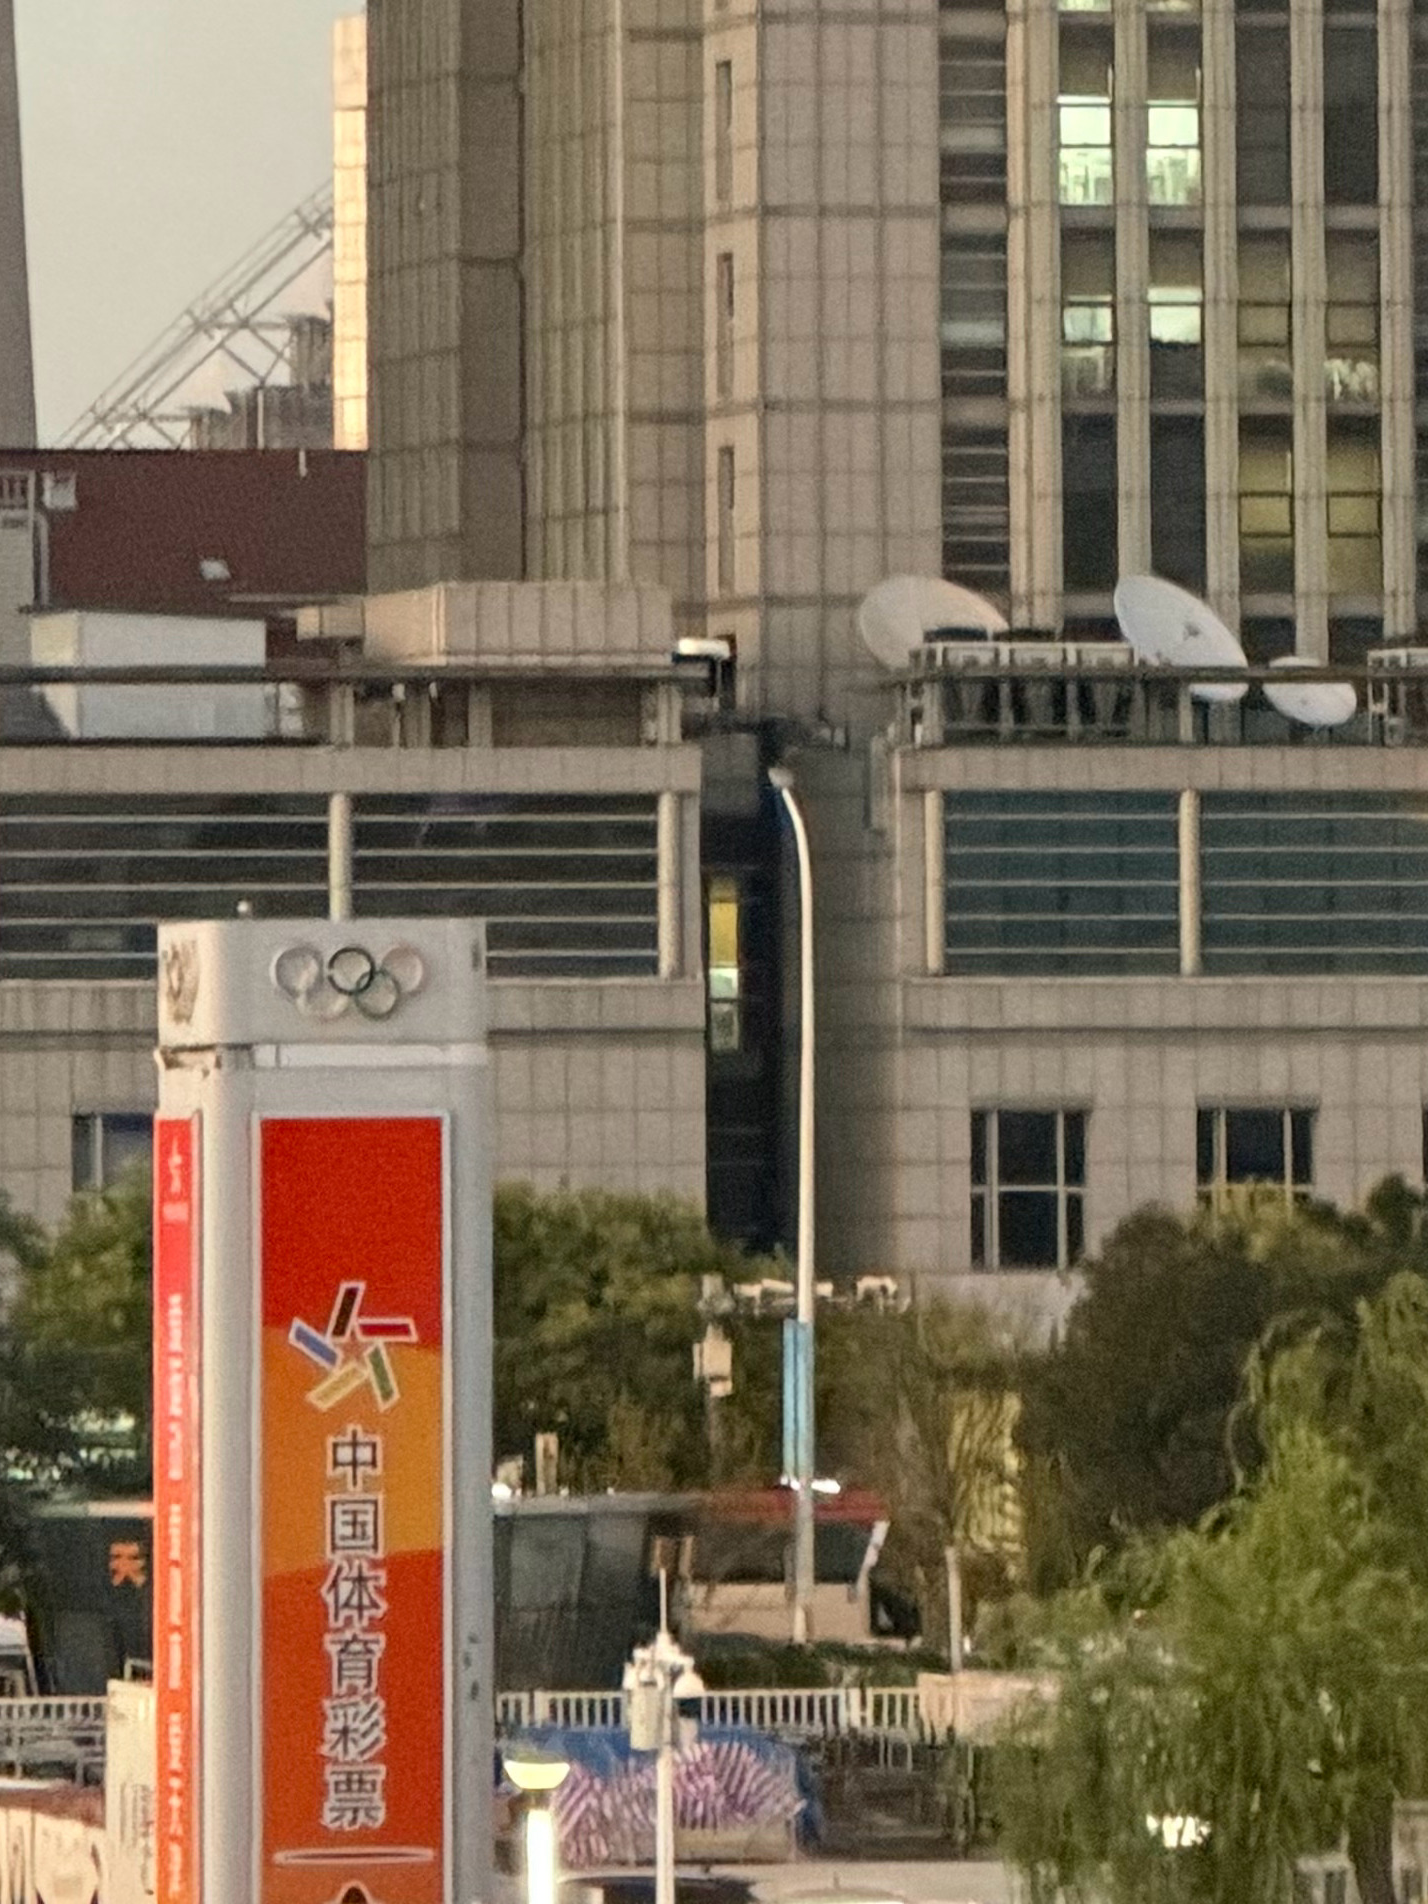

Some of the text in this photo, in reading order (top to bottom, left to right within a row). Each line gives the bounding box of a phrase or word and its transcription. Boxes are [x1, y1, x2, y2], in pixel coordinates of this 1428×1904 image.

[322, 1425, 388, 1829] 中国体育彩票
